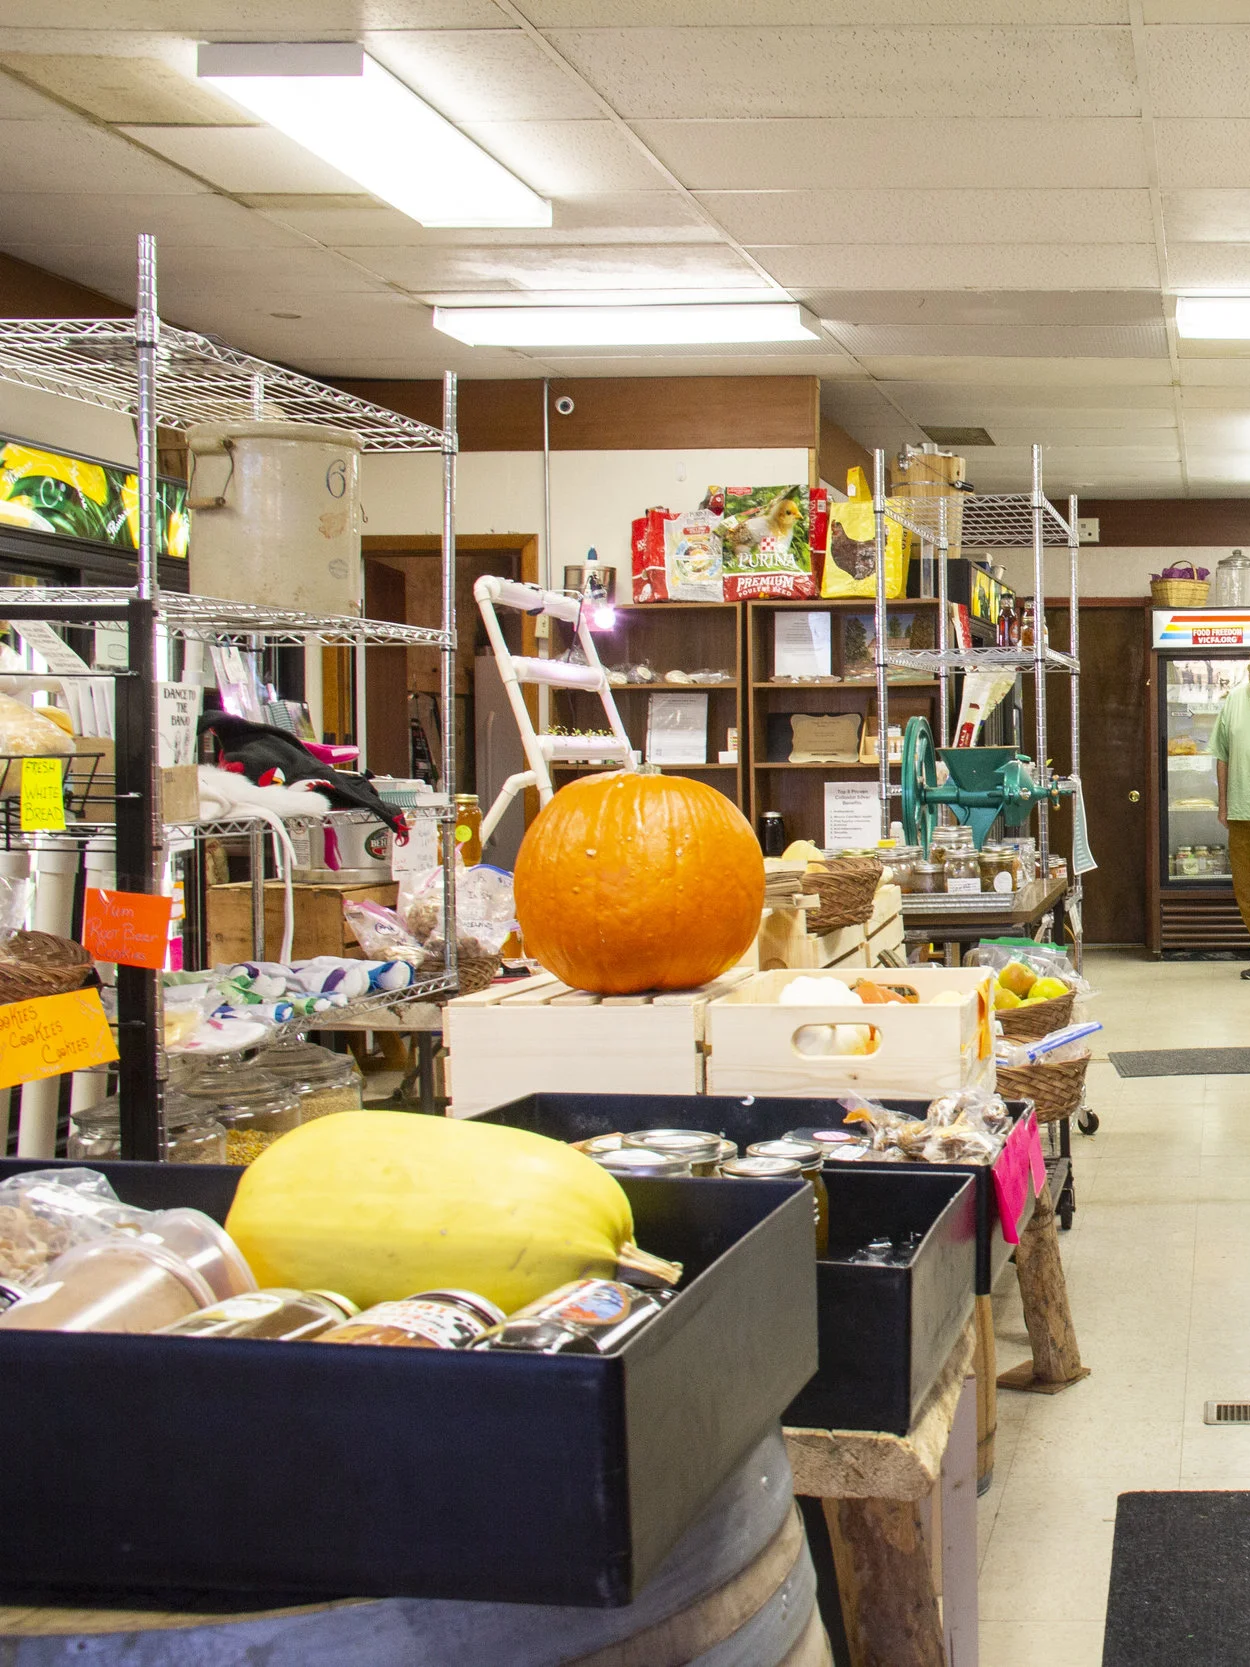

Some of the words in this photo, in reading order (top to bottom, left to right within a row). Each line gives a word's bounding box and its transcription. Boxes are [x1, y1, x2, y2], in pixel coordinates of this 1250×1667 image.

[326, 459, 346, 499] 6
[738, 552, 798, 570] PURINA
[736, 576, 795, 593] PREMIUM
[1198, 636, 1237, 644] VICFA.ORG
[1212, 628, 1242, 636] FREEDOM
[163, 688, 187, 700] DANCE
[176, 702, 188, 713] THE
[26, 761, 56, 774] FRESH
[24, 784, 60, 800] WHITE
[24, 802, 63, 822] BREAD
[99, 897, 135, 918] Yum
